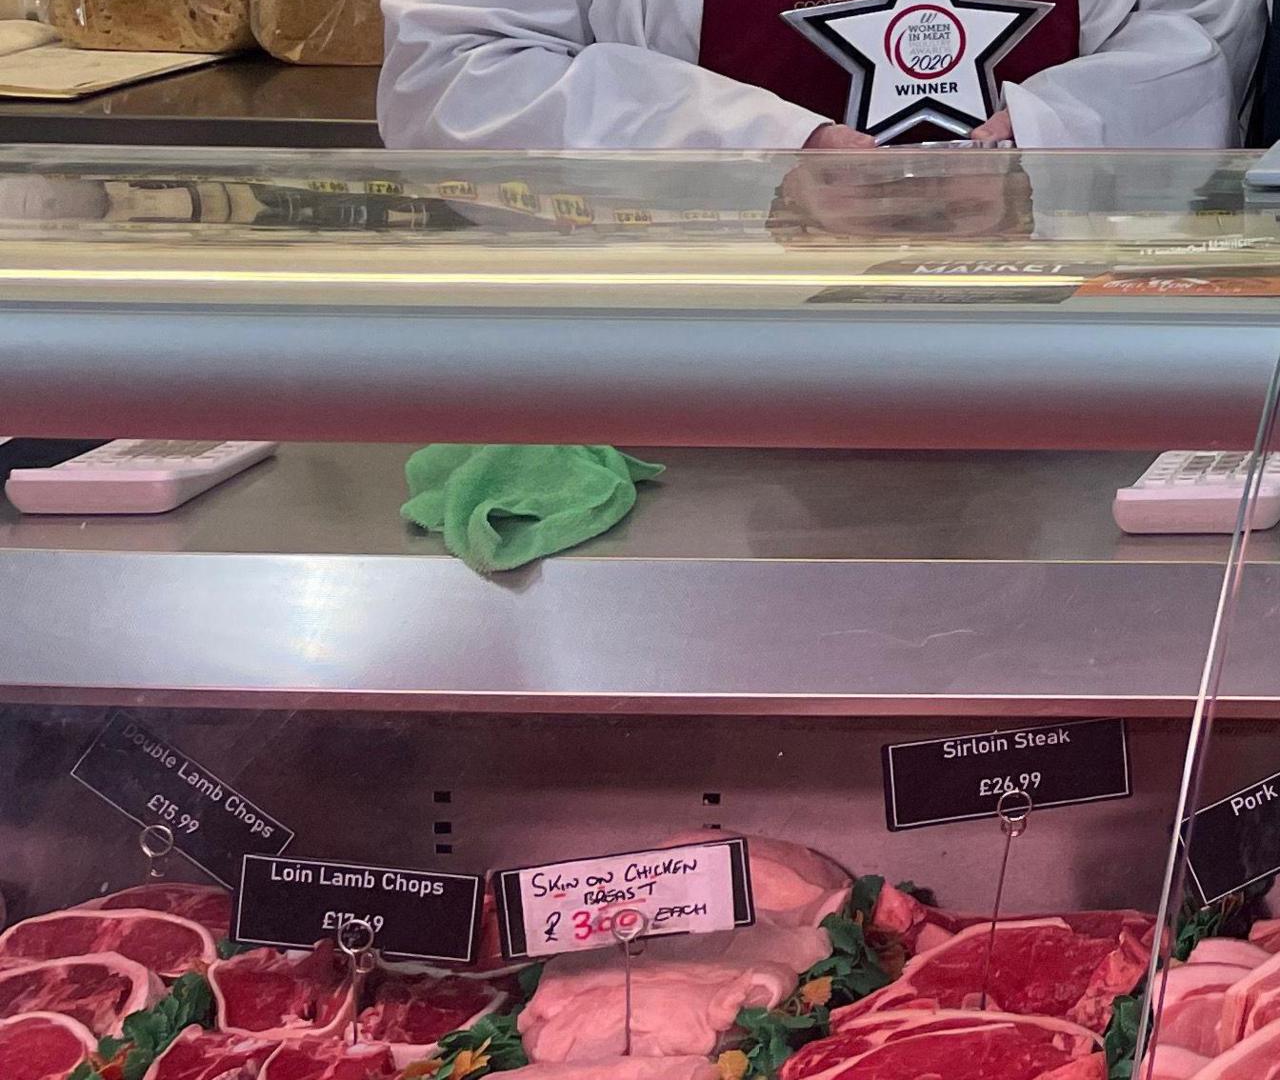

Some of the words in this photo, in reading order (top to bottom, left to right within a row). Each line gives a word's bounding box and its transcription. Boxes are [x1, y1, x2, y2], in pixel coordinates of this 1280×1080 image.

[908, 23, 951, 33] WOMEN
[909, 33, 921, 41] IN
[923, 32, 951, 40] MEAT
[910, 54, 953, 71] 2020
[895, 81, 958, 97] WINNER
[943, 733, 1008, 760] Sirloin
[1012, 728, 1072, 751] Steak
[120, 723, 178, 770] Double
[176, 761, 224, 803] Lamb
[225, 793, 275, 839] Chops
[979, 770, 1042, 797] £26.99
[1229, 784, 1277, 817] Pork
[146, 792, 201, 837] £15.99
[269, 861, 314, 884] Loin
[318, 864, 376, 889] Lamb
[381, 872, 445, 899] Chops
[531, 874, 580, 899] SKIN
[585, 873, 615, 889] ON
[623, 858, 699, 884] CHICKEN
[582, 884, 656, 908] BREAST
[653, 902, 708, 923] EACH
